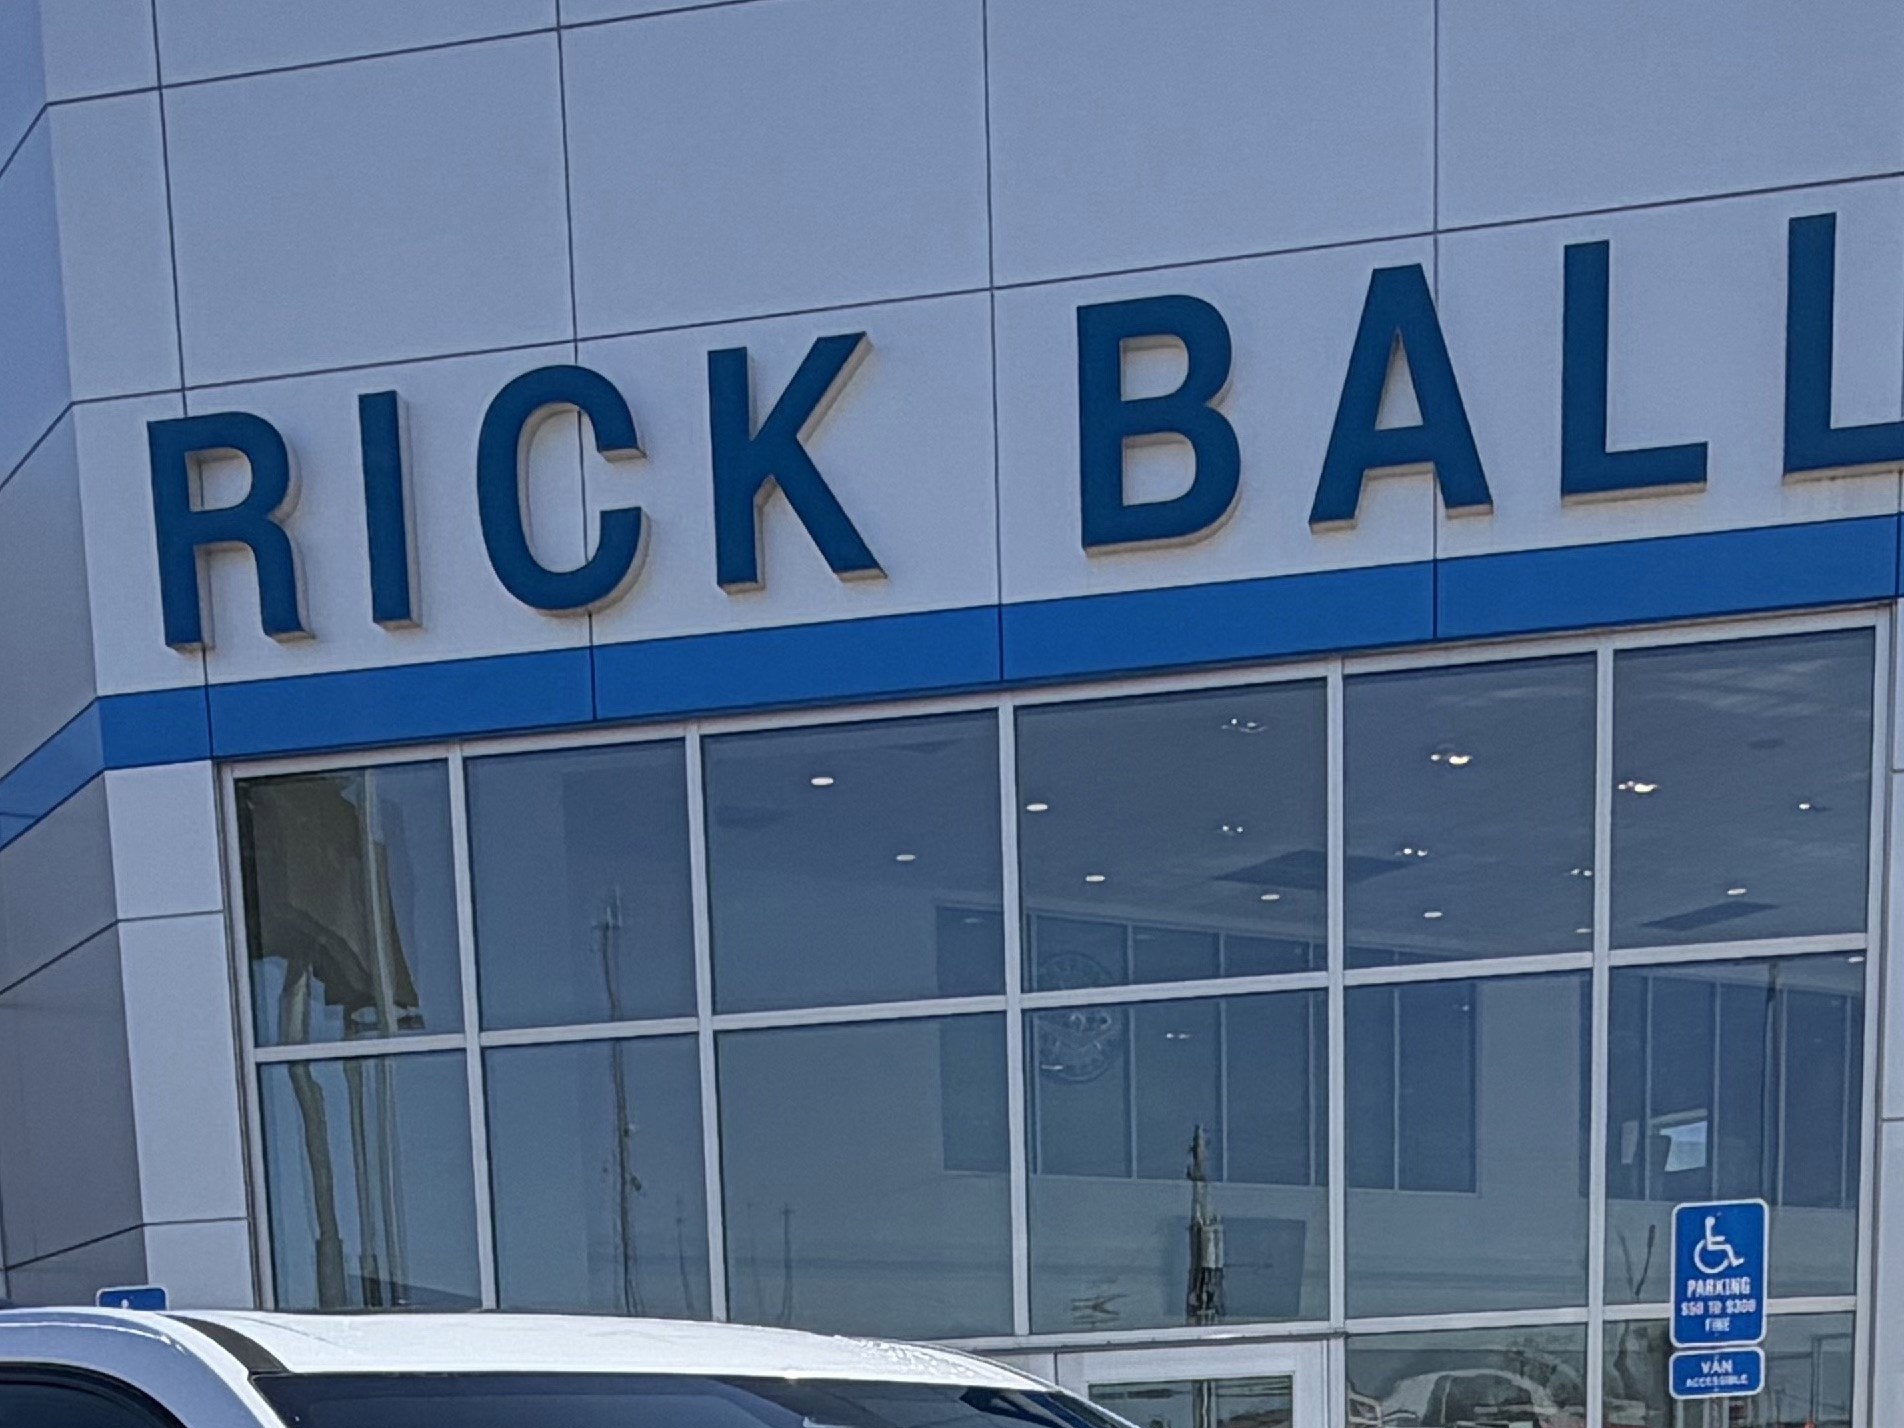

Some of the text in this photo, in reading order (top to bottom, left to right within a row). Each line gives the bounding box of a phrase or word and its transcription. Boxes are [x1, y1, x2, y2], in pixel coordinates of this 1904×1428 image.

[146, 331, 893, 653] RICK
[1687, 1277, 1751, 1298] PARKING
[1681, 1301, 1704, 1316] $50
[1708, 1301, 1722, 1315] TO
[1704, 1317, 1730, 1332] FINE
[1701, 1359, 1733, 1374] VAN
[1686, 1374, 1749, 1387] ACCESSIBLE
